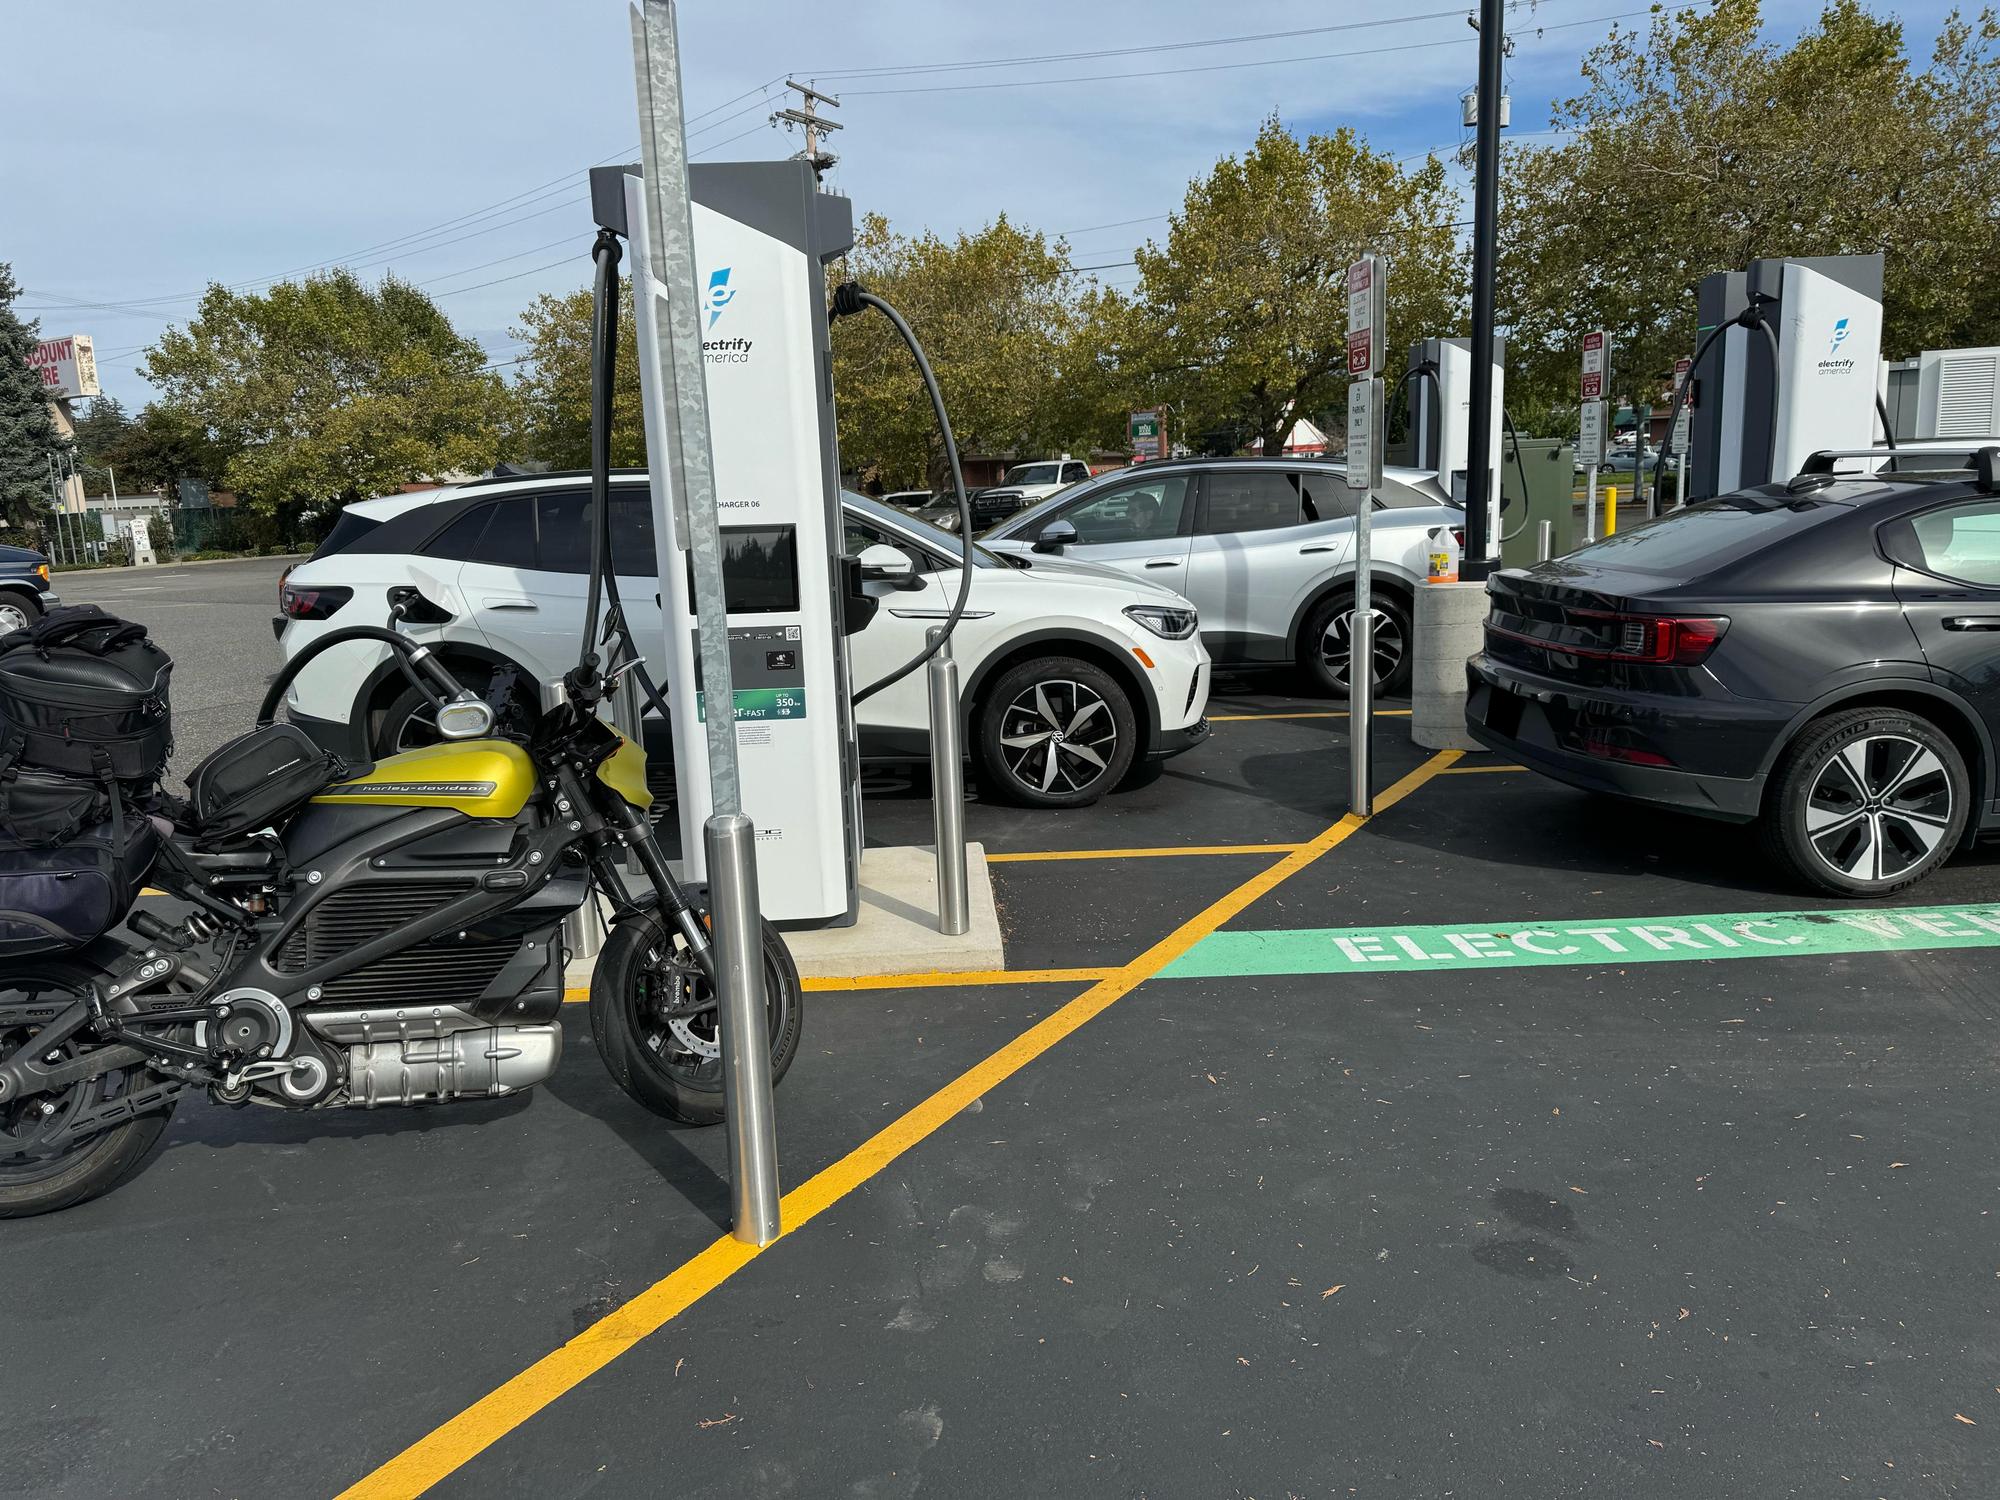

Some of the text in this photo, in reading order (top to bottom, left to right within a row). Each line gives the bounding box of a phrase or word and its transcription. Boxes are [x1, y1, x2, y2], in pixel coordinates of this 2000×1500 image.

[703, 338, 752, 352] ectrify
[24, 340, 72, 366] SCOUNT
[704, 351, 748, 363] merica
[1818, 359, 1854, 368] electrify
[1819, 367, 1851, 375] america
[751, 500, 760, 508] 06
[776, 698, 794, 707] 350
[1332, 920, 1806, 962] ELECTRIC
[673, 975, 681, 1003] brembo
